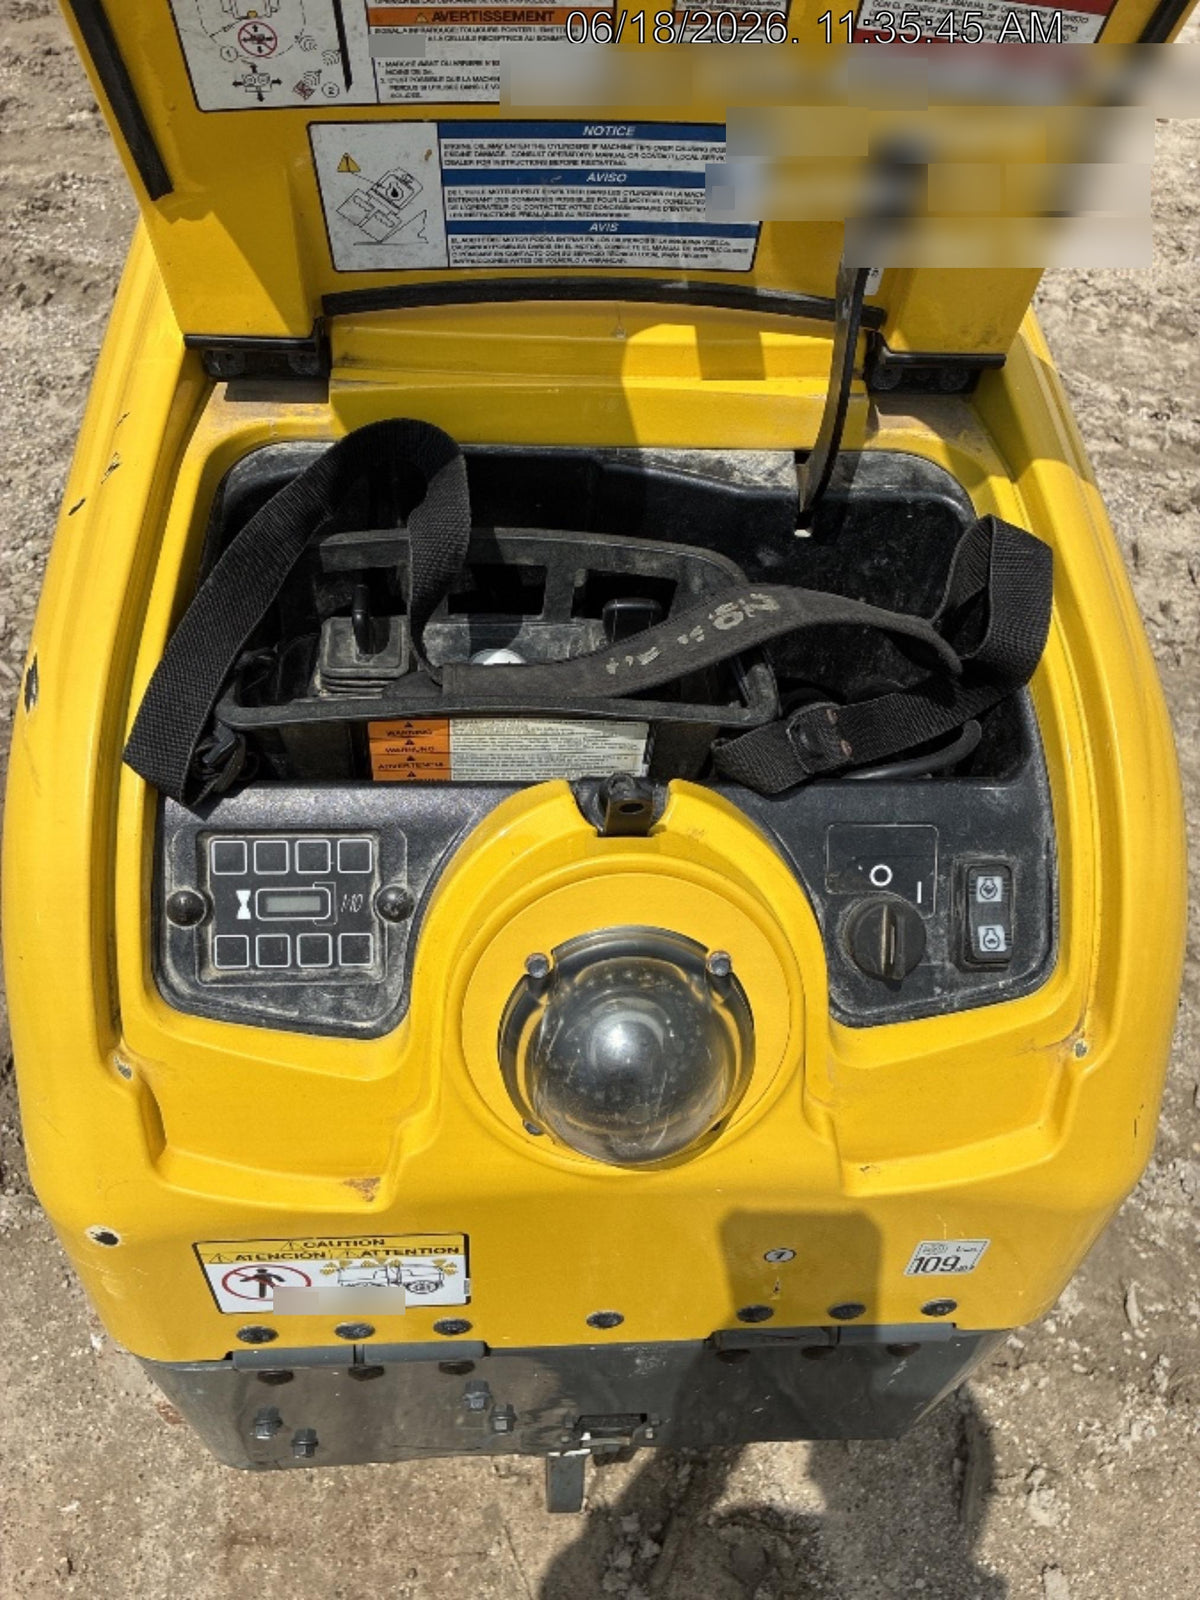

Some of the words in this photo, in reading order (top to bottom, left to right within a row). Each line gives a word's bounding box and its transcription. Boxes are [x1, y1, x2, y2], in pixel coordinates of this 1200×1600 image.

[431, 10, 555, 22] AVERTISSEMENT
[582, 125, 636, 136] NOTICE
[586, 172, 628, 182] AVISO
[589, 223, 619, 232] AVIS
[302, 1238, 386, 1249] CAUTION
[361, 1246, 460, 1258] ATTENTION
[913, 1255, 961, 1274] 109
